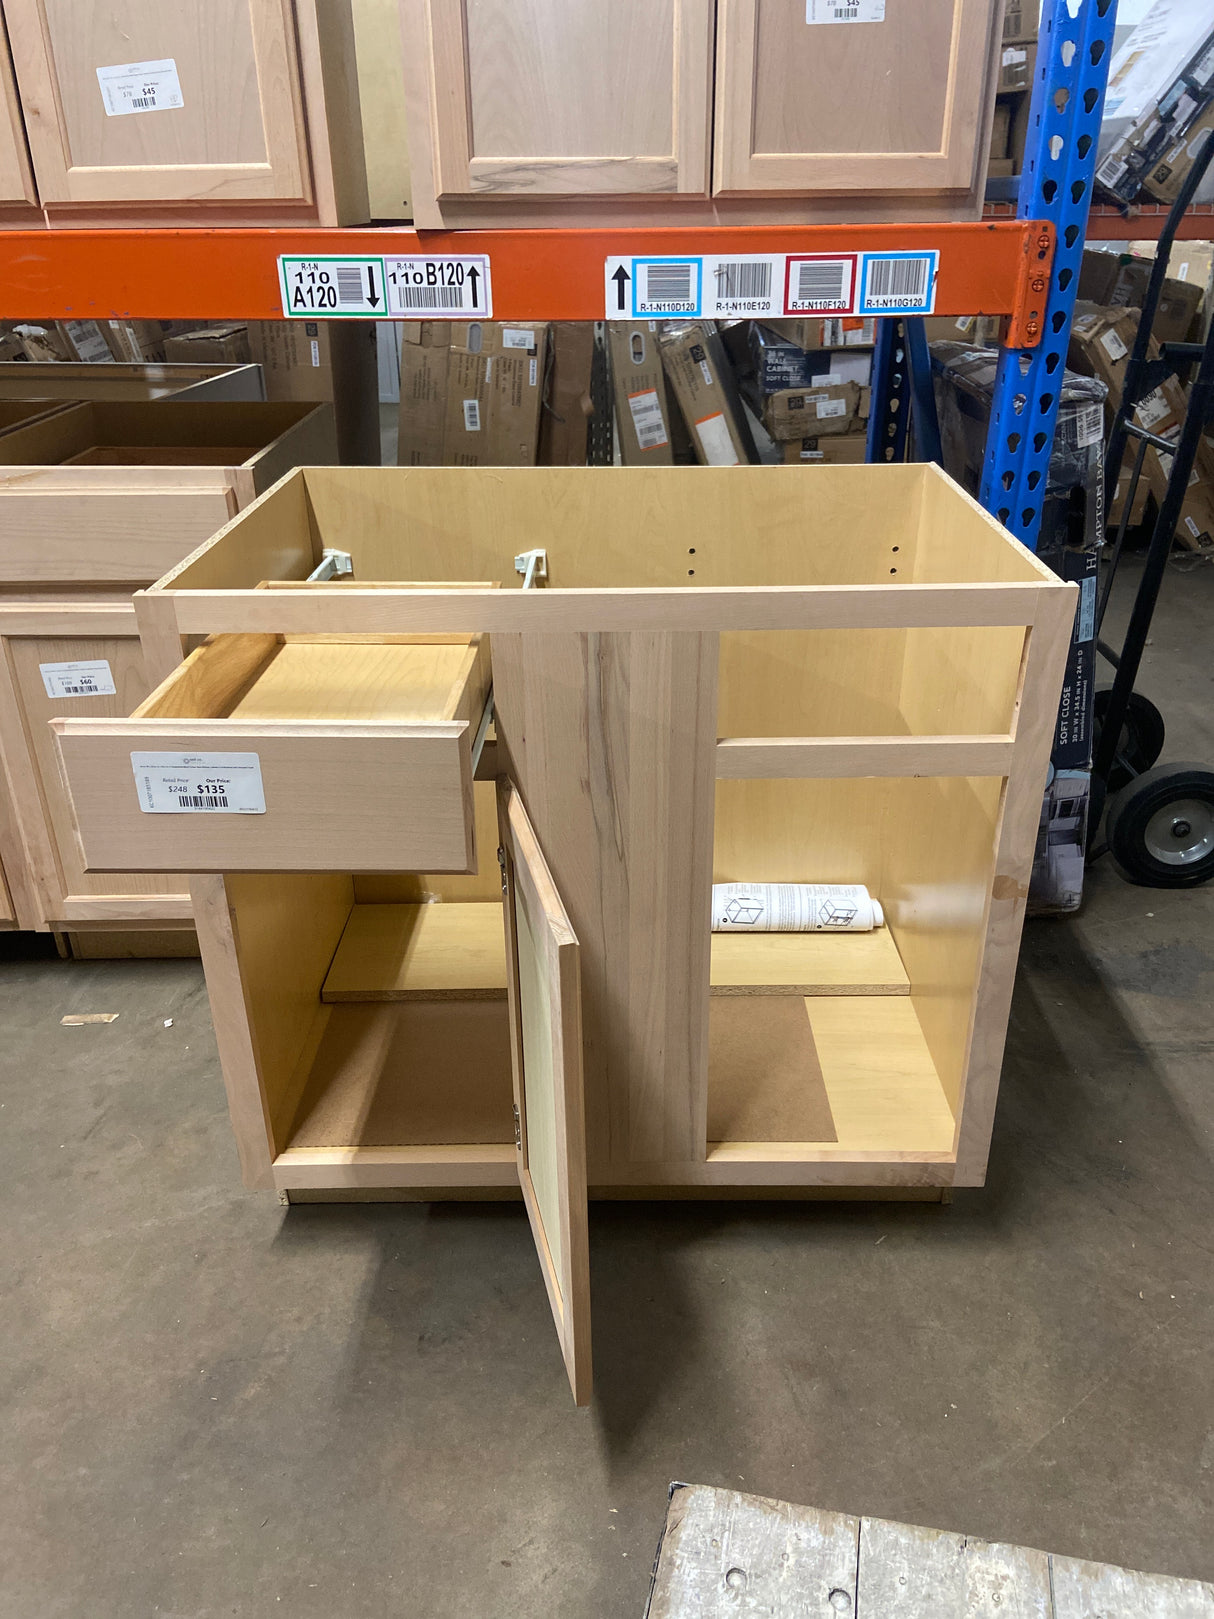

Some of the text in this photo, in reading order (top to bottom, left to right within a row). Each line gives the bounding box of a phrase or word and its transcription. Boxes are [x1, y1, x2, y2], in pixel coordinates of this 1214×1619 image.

[142, 87, 156, 96] $45
[301, 262, 319, 271] R-1-N
[397, 262, 415, 271] R-1-N
[294, 271, 330, 284] 110
[293, 286, 337, 308] A120
[640, 303, 695, 312] R-1-N110D120
[716, 301, 771, 311] R-1-N110E120
[792, 300, 847, 310] R-1-N110F120
[866, 298, 923, 308] R-1-N110G120
[1060, 686, 1071, 745] SOFT CLOSE
[197, 784, 225, 794] $135
